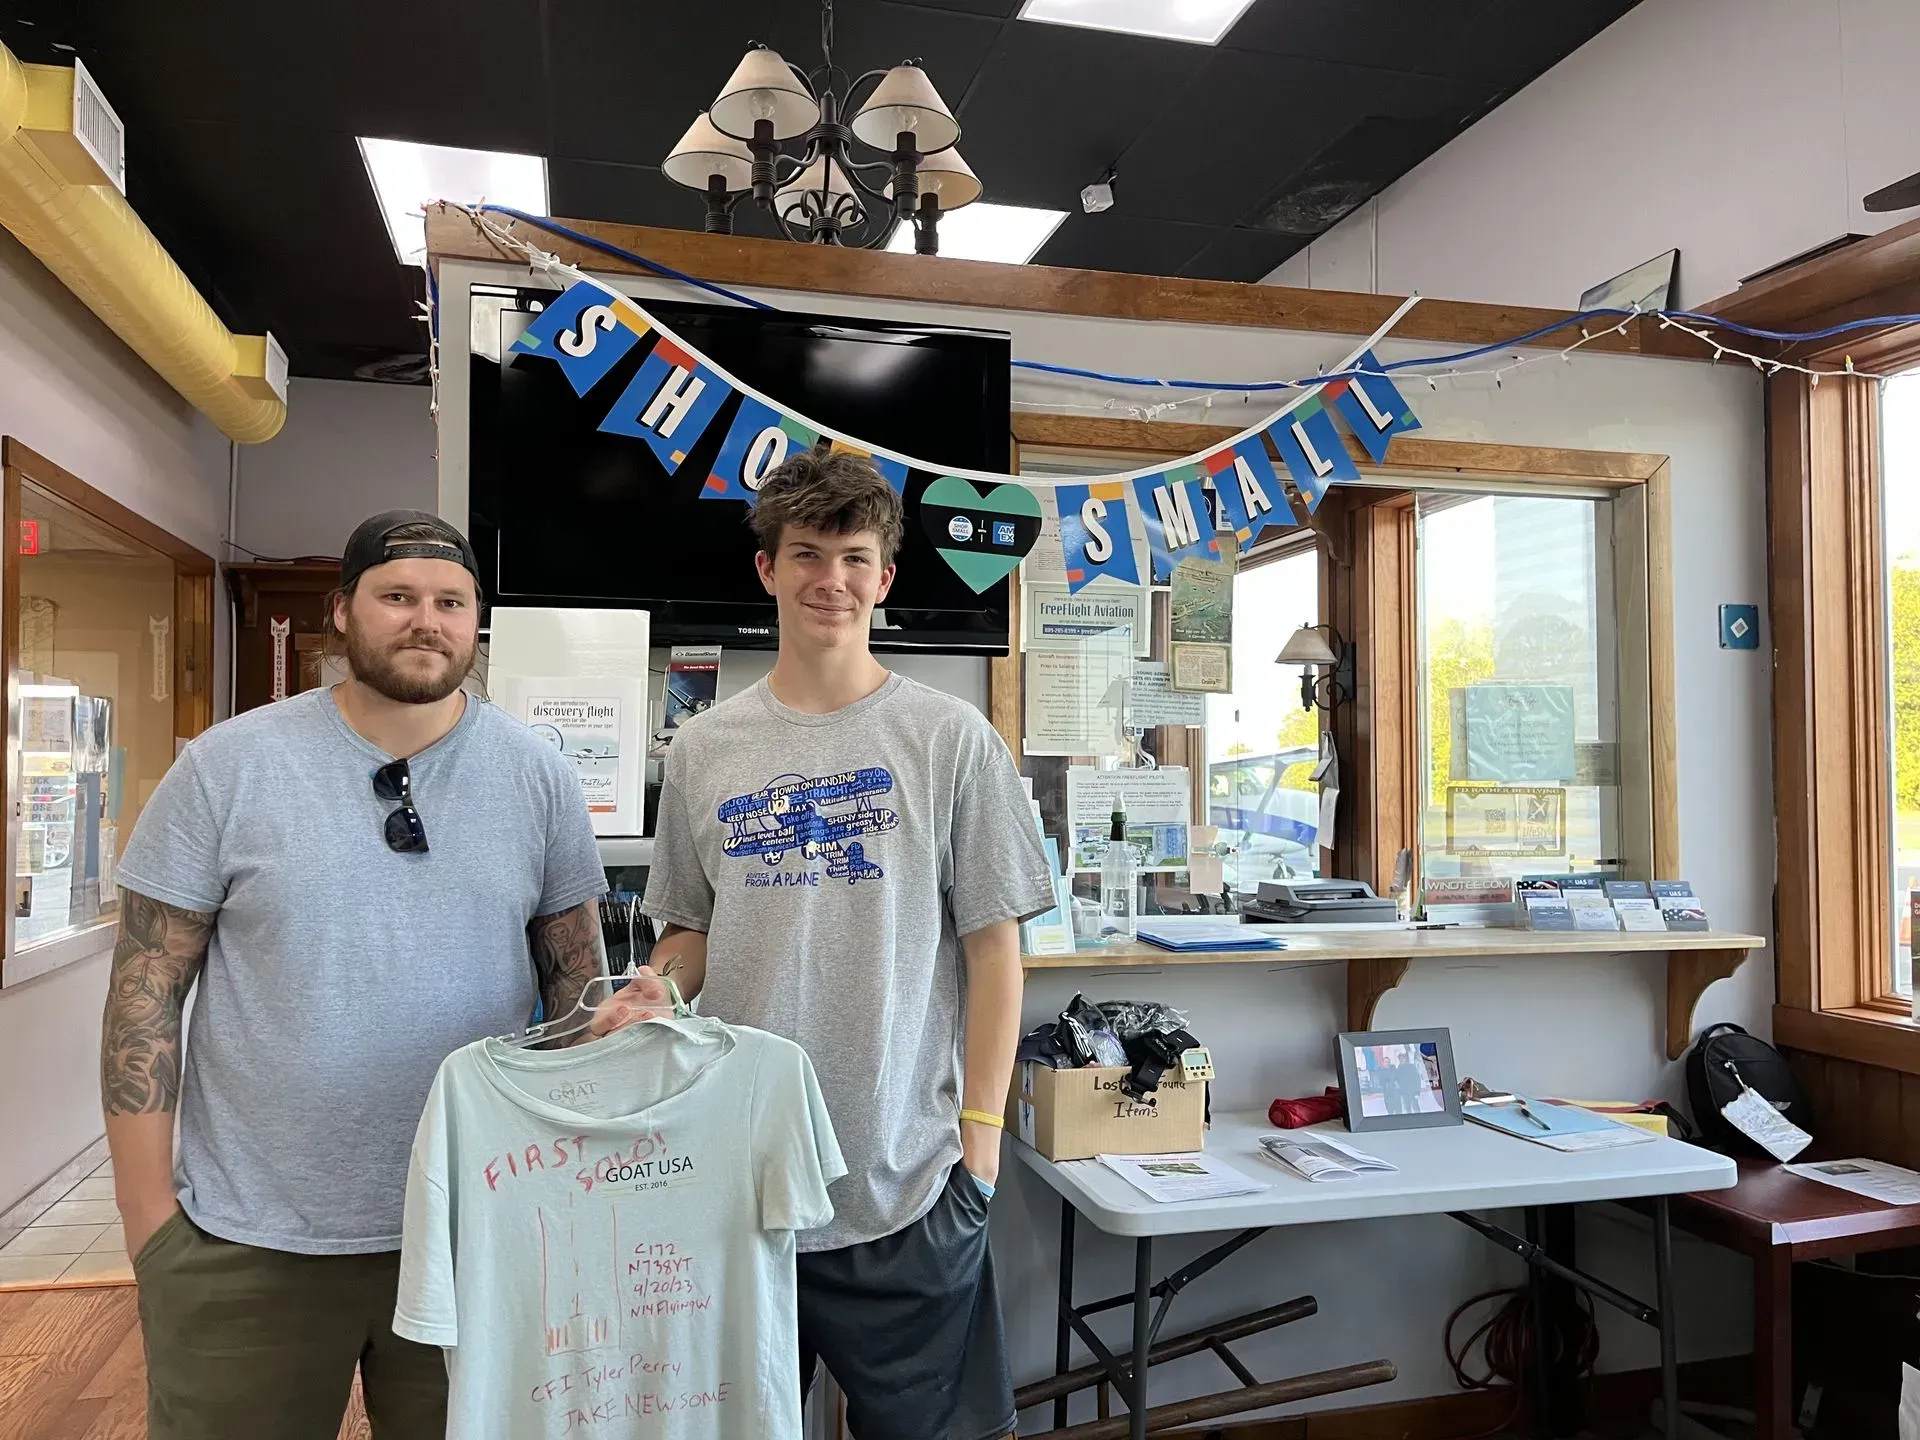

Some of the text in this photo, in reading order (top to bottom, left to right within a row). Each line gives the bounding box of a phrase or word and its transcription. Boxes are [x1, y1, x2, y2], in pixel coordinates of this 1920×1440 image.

[553, 304, 790, 492] SHO
[1080, 377, 1394, 567] SMALL
[1040, 602, 1134, 618] FreeFlight Aviation
[738, 627, 770, 635] TOSHIBA
[533, 705, 614, 719] discovery flight
[801, 780, 814, 791] ON
[815, 771, 856, 788] LANDING
[726, 812, 745, 823] KEEP
[745, 807, 769, 820] NOSE
[827, 813, 856, 826] SHINY
[875, 809, 892, 824] UP
[846, 819, 873, 832] greasy
[762, 836, 795, 847] centered
[825, 850, 845, 860] TRIM
[745, 871, 820, 888] FROM A PLANE
[1093, 1075, 1125, 1092] Lost
[1113, 1101, 1159, 1119] Items
[483, 1135, 591, 1192] FIRST
[605, 1155, 694, 1183] GOAT USA
[635, 1179, 668, 1192] EST. 2016
[634, 1242, 677, 1256] C172
[628, 1256, 694, 1276] N738YT
[531, 1353, 682, 1404] CFI Tyler Perry
[561, 1397, 621, 1436] JAKE
